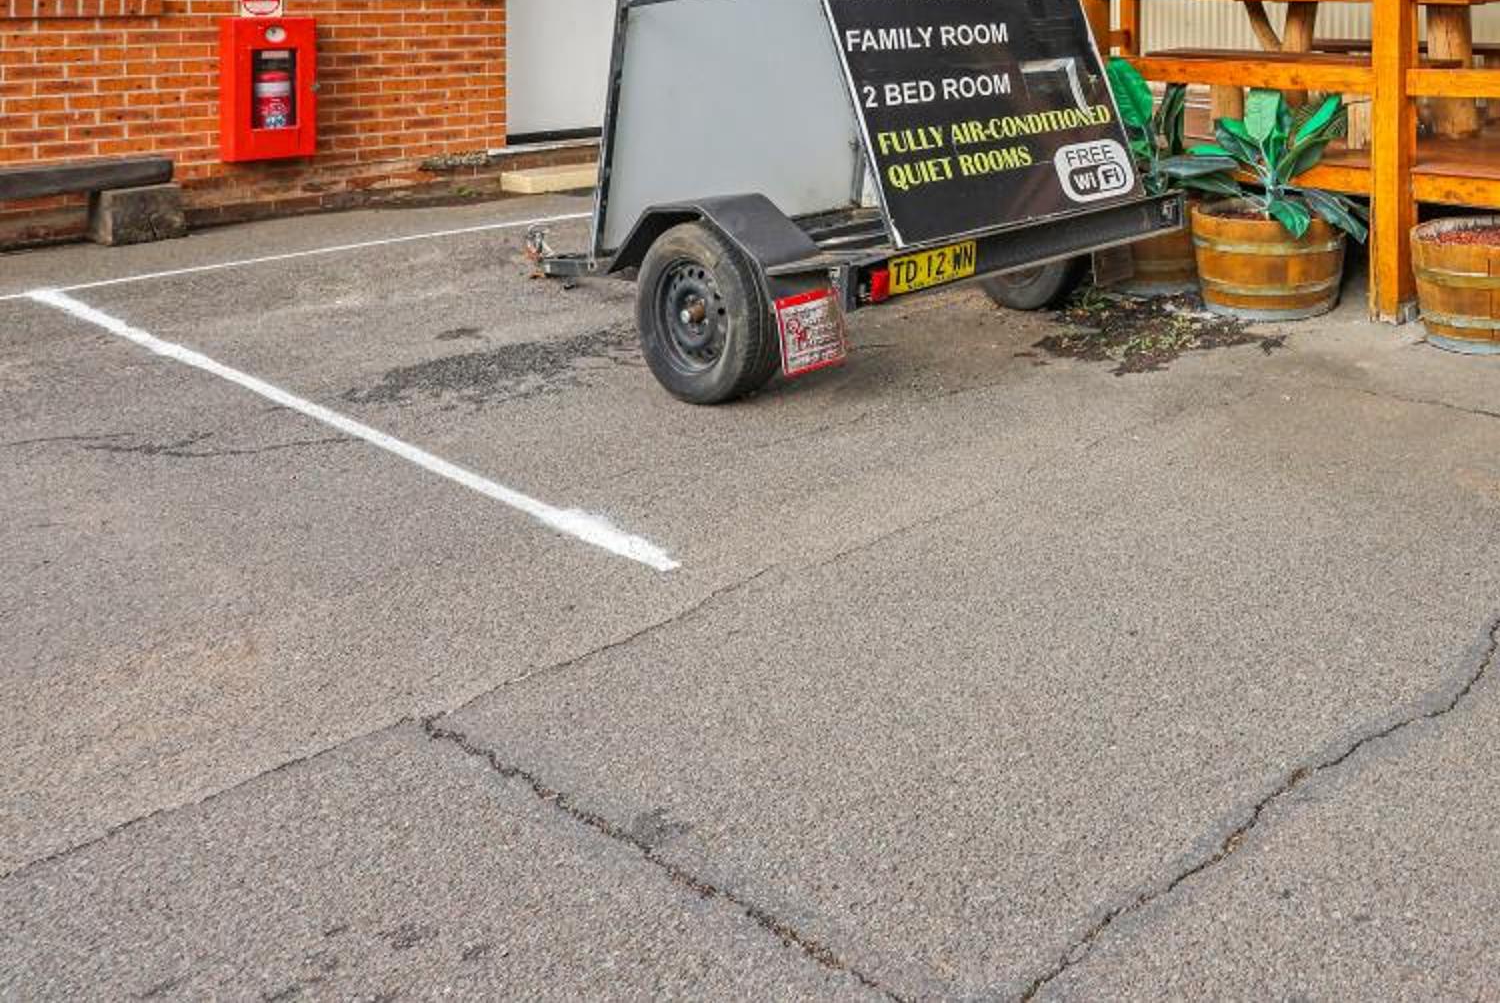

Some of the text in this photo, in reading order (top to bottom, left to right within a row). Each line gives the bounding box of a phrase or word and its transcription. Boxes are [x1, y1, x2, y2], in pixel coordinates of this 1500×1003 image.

[845, 22, 1009, 53] FAMILY ROOM
[863, 72, 1012, 109] 2 BED ROOM
[877, 105, 1110, 156] FULLY AIR-CONDITIONED
[887, 145, 1033, 191] QUIET ROOMS
[1065, 144, 1116, 165] FREE
